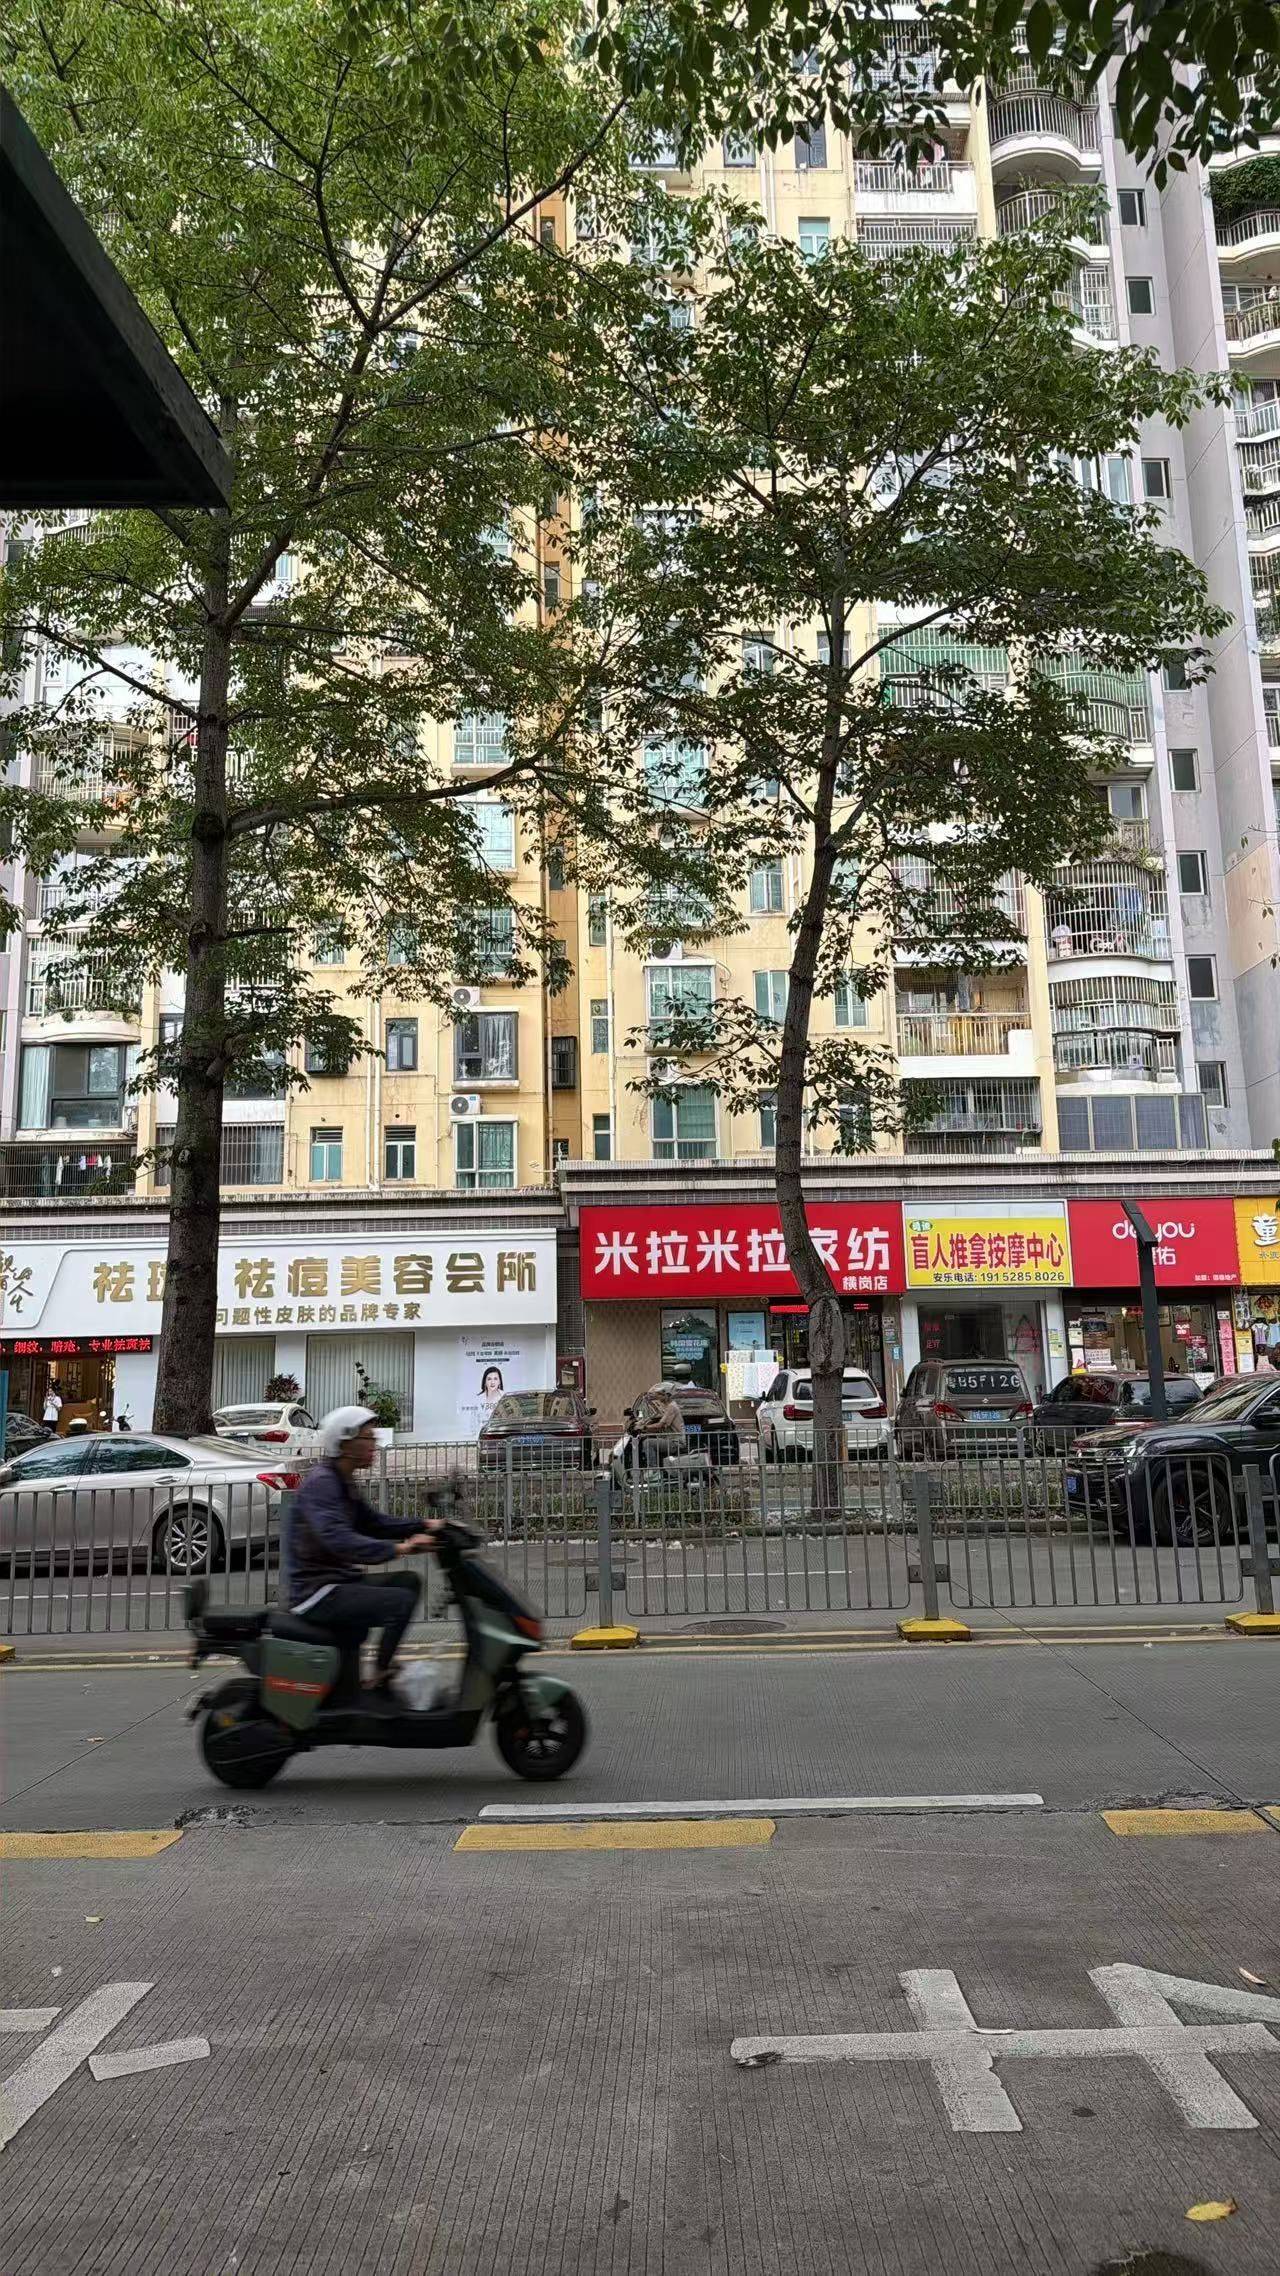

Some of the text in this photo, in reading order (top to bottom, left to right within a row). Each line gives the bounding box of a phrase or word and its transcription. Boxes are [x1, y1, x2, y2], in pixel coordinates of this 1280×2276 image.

[595, 1226, 890, 1275] 米拉米拉家纺
[910, 1231, 1065, 1270] 盲人推拿按摩中心
[234, 1251, 537, 1299] 祛痘美容会所
[842, 1275, 888, 1291] 横岗店
[981, 1271, 999, 1282] 191
[1002, 1271, 1032, 1282] 5285
[1034, 1271, 1065, 1282] 8026
